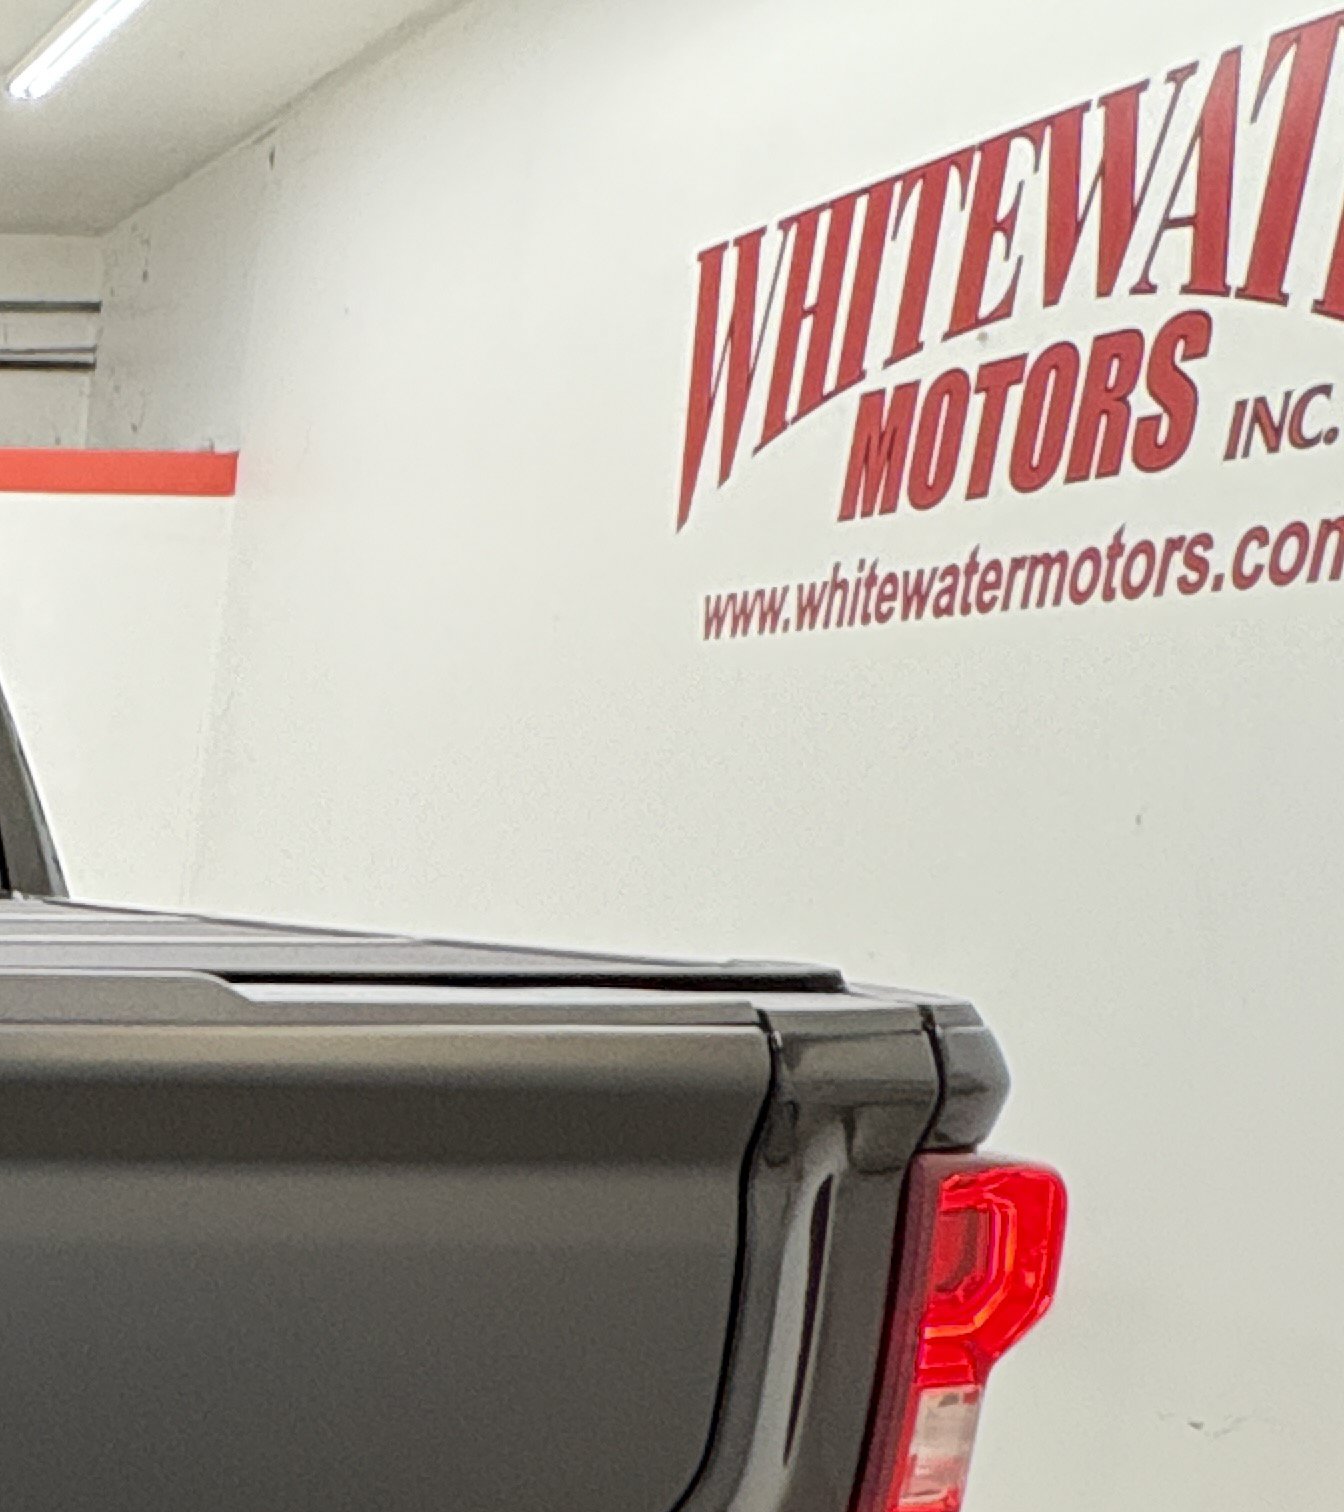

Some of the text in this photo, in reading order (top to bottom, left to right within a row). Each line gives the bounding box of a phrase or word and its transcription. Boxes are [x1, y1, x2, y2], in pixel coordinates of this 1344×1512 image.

[675, 10, 1344, 535] WHITEWAT
[837, 309, 1339, 522] MOTORS INC.
